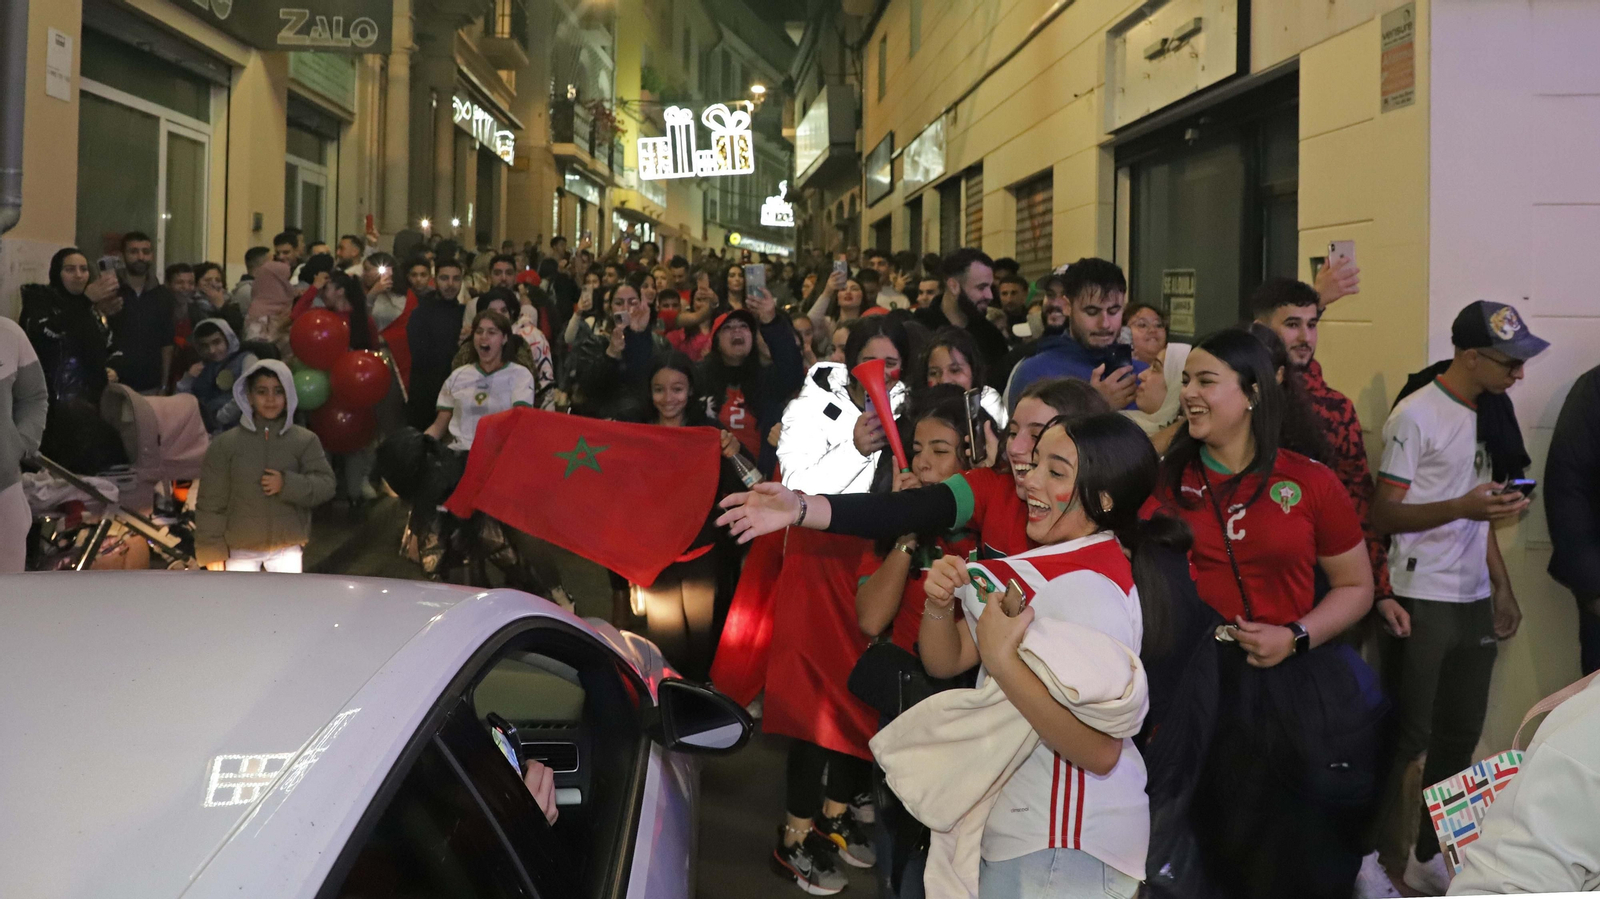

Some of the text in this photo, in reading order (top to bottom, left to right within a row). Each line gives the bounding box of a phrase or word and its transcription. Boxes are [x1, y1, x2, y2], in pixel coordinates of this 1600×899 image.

[277, 8, 378, 48] ZALO
[729, 406, 745, 429] 2
[1227, 503, 1246, 541] 2
